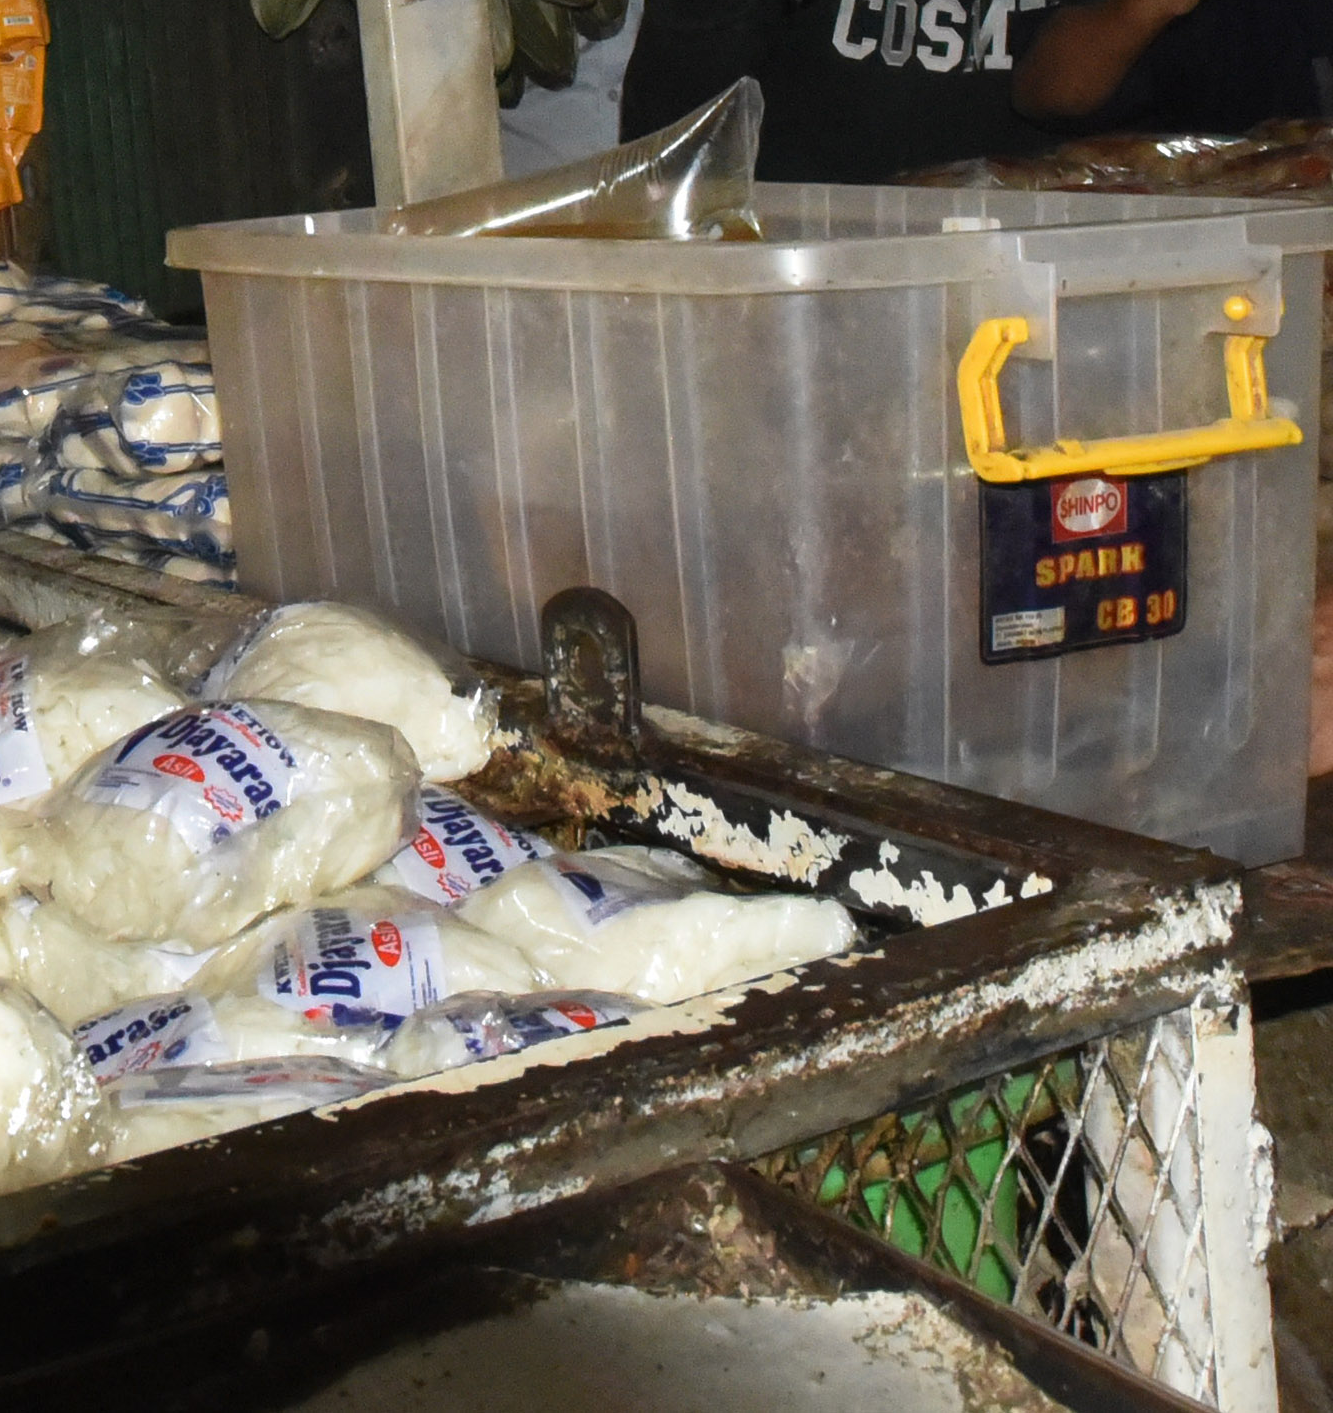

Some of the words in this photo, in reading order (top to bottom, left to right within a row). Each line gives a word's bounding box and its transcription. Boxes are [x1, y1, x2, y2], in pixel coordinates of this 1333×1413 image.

[1060, 492, 1118, 520] SHINPO
[1035, 542, 1146, 588] SPARK
[1097, 596, 1138, 631] CB
[1146, 588, 1177, 625] 30
[156, 714, 282, 821] Djayaras
[159, 756, 198, 778] Asli
[376, 924, 400, 956] Asli
